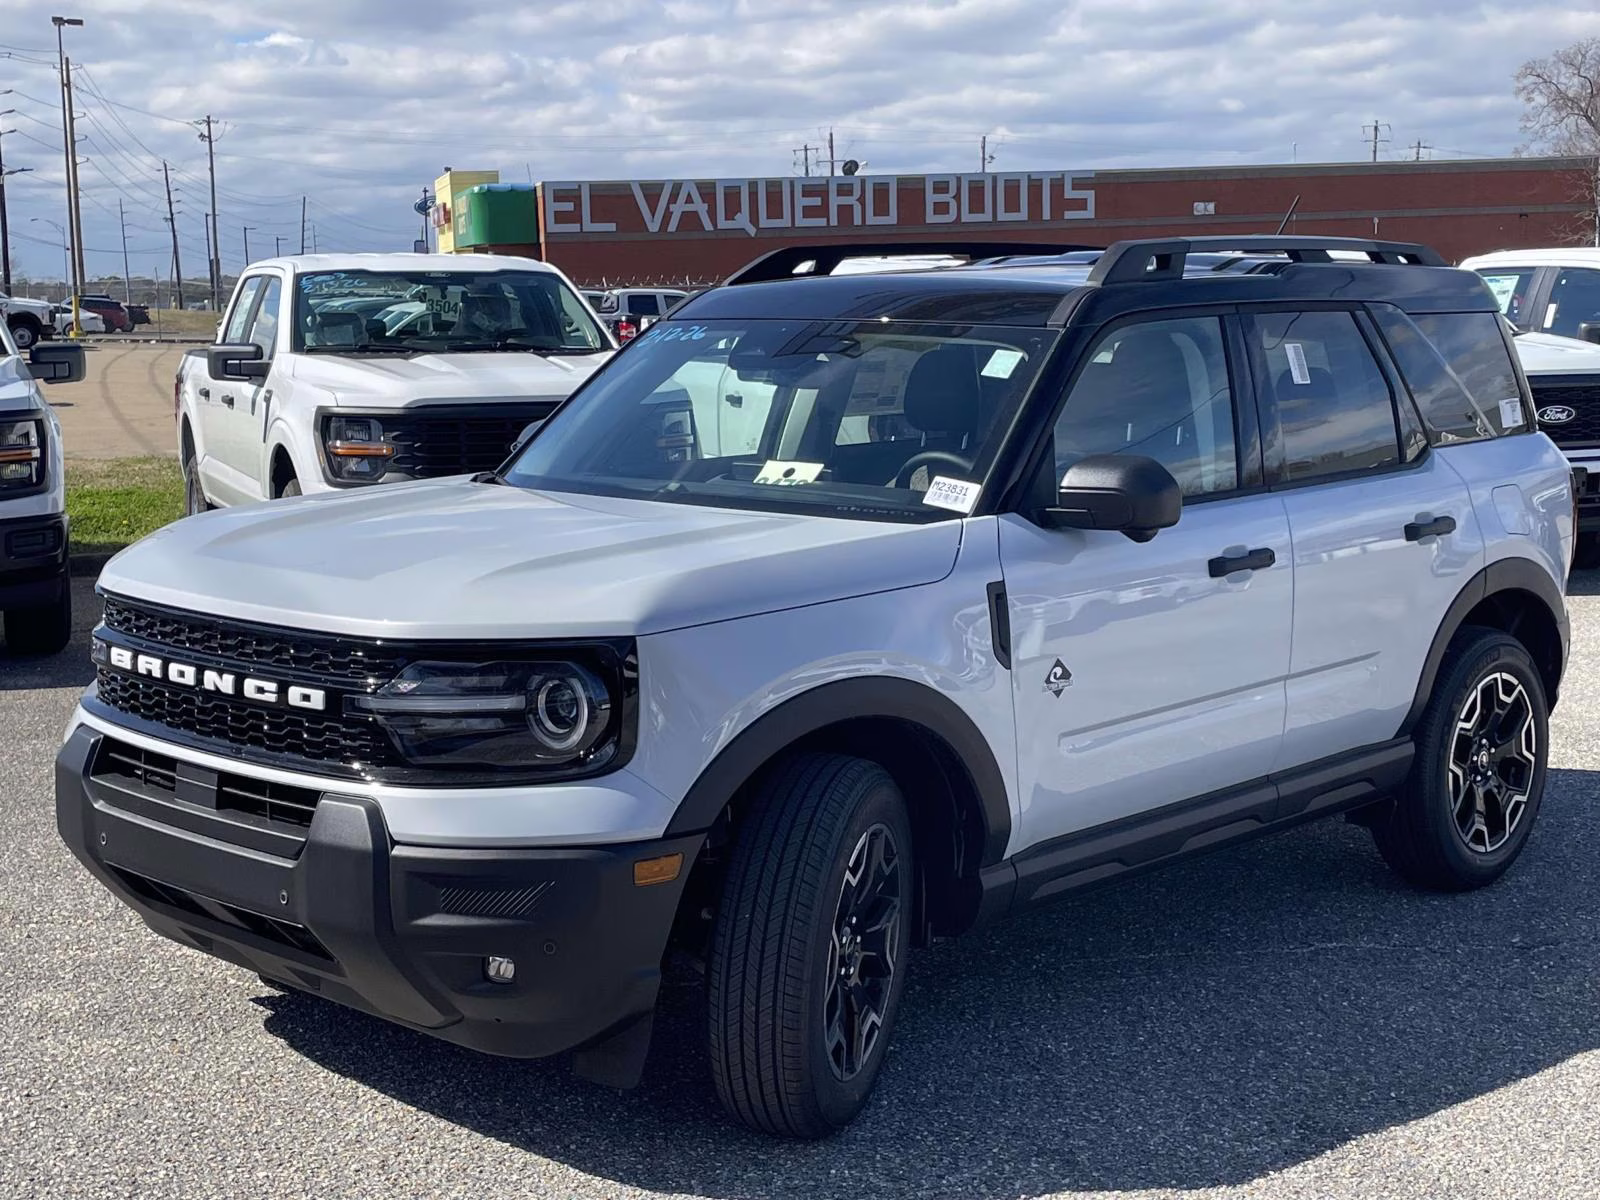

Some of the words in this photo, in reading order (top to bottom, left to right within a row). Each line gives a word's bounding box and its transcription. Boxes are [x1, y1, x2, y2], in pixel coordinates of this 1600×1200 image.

[545, 181, 617, 233] EL
[630, 176, 897, 237] VAQUERO
[925, 171, 1095, 224] BOOTS
[427, 299, 459, 315] 3504
[1542, 407, 1570, 421] Ford
[932, 480, 969, 496] M23831
[110, 646, 326, 711] BRONCO
